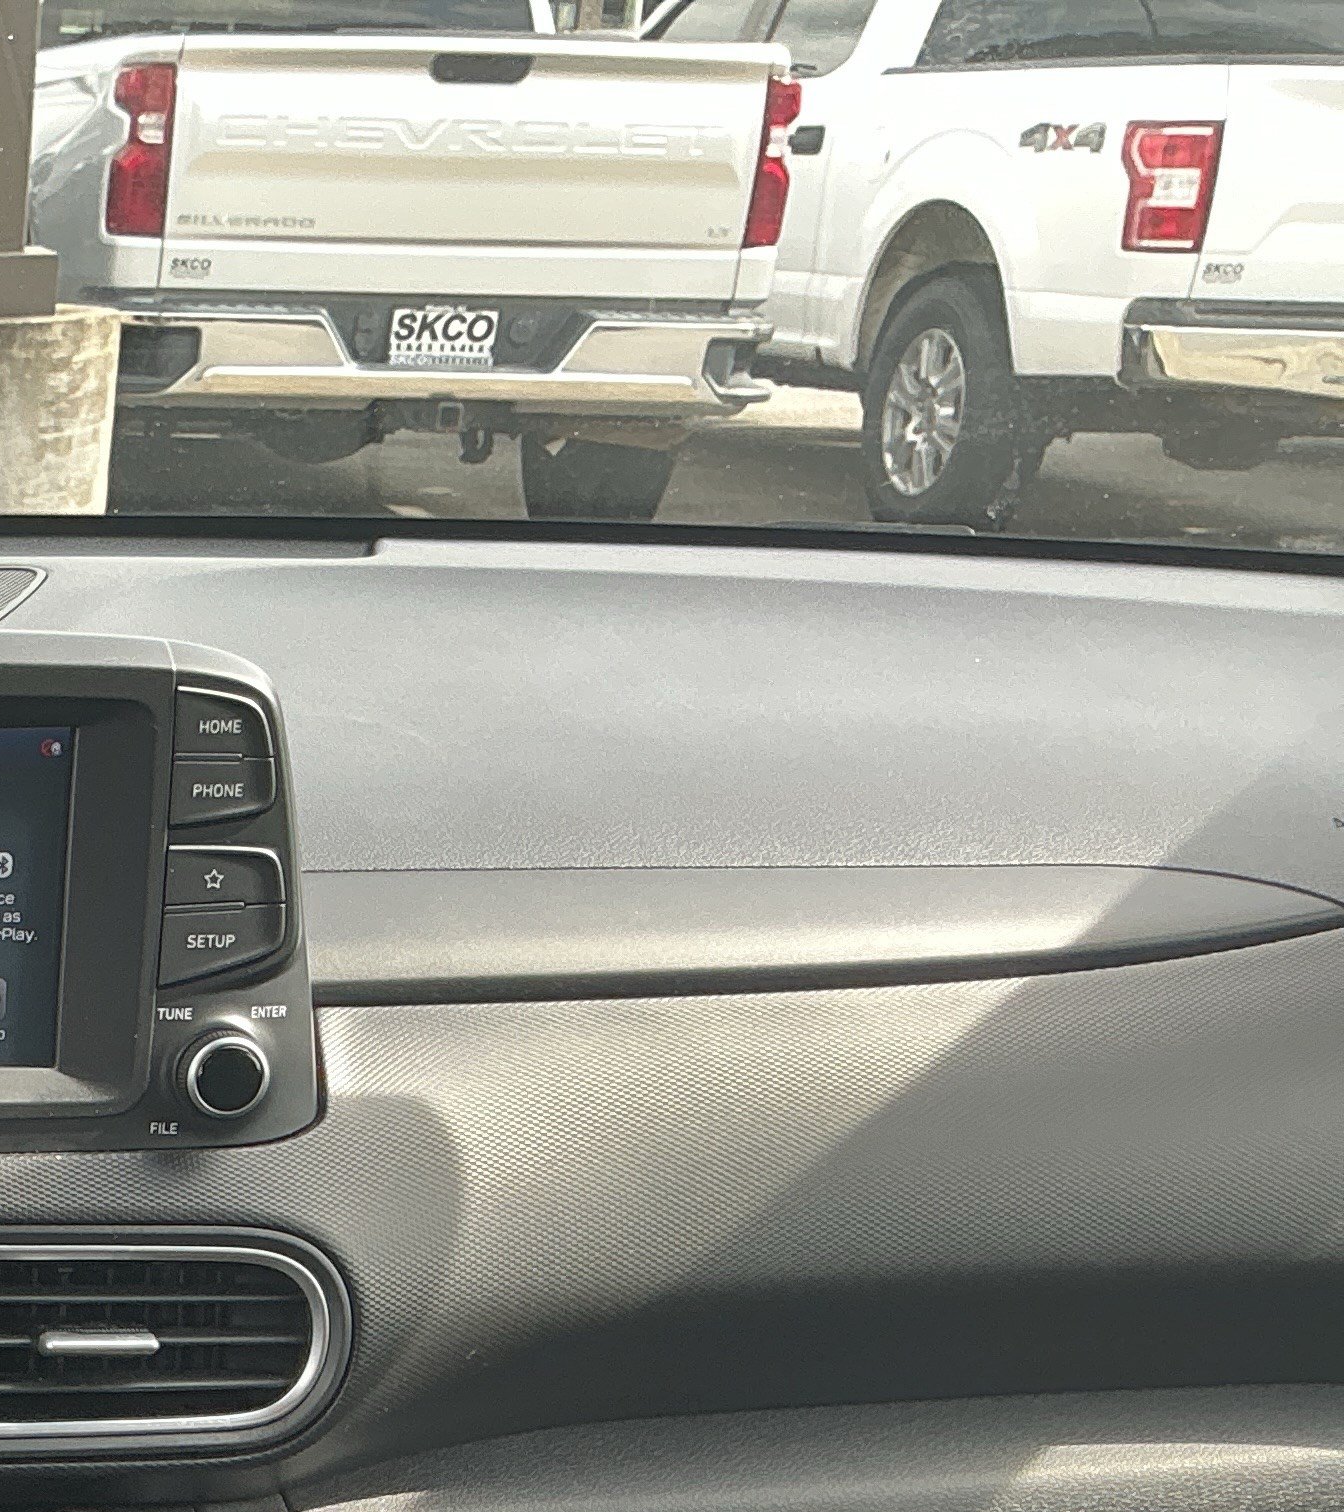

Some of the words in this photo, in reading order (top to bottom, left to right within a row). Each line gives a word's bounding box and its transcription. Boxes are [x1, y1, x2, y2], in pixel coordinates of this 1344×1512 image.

[216, 113, 724, 157] CHEVROLET
[177, 213, 316, 229] SILVERADO
[393, 313, 495, 342] SKCO
[198, 719, 242, 735] HOME
[192, 783, 244, 798] PHONE
[0, 913, 21, 924] as
[187, 933, 236, 949] SETUP
[157, 1007, 193, 1021] TUNE
[251, 1005, 287, 1019] ENTER
[149, 1121, 178, 1135] FILE
